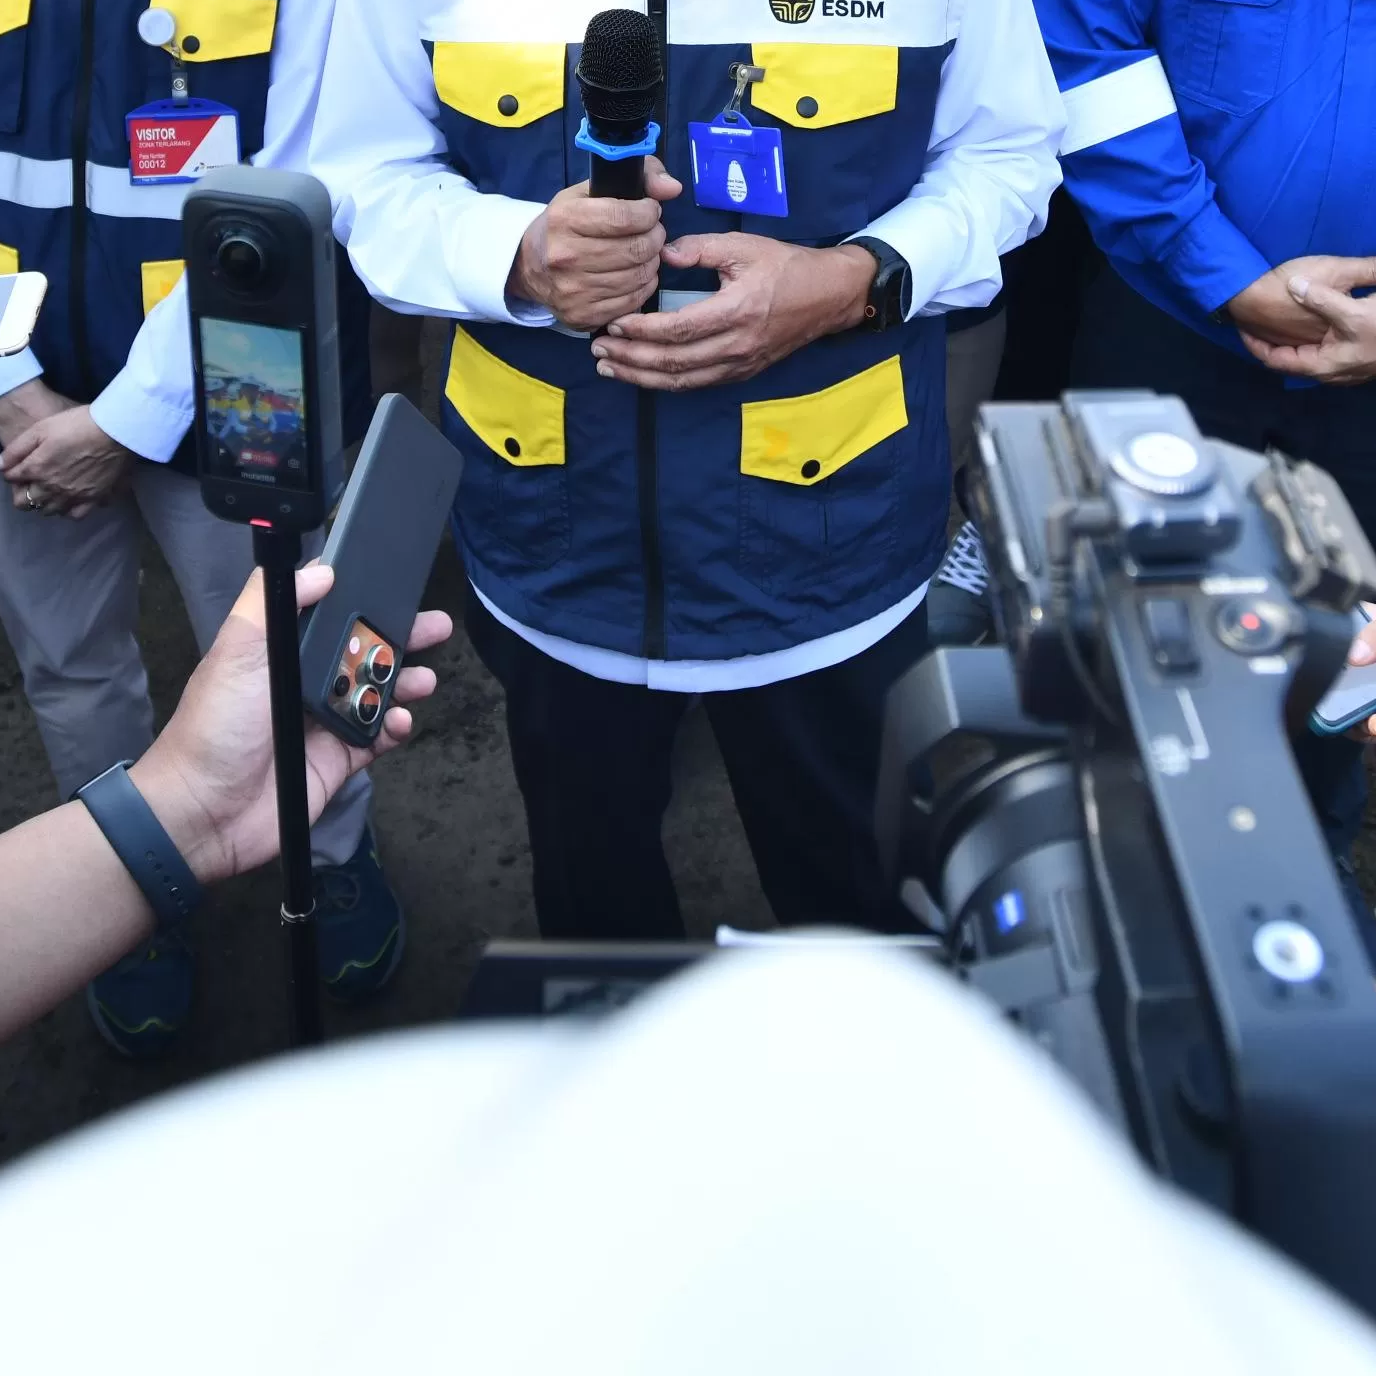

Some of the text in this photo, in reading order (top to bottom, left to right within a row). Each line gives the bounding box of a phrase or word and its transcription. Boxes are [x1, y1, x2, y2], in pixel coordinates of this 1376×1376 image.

[822, 0, 885, 18] ESDM
[136, 127, 175, 141] VISITOR
[139, 160, 165, 169] 00012
